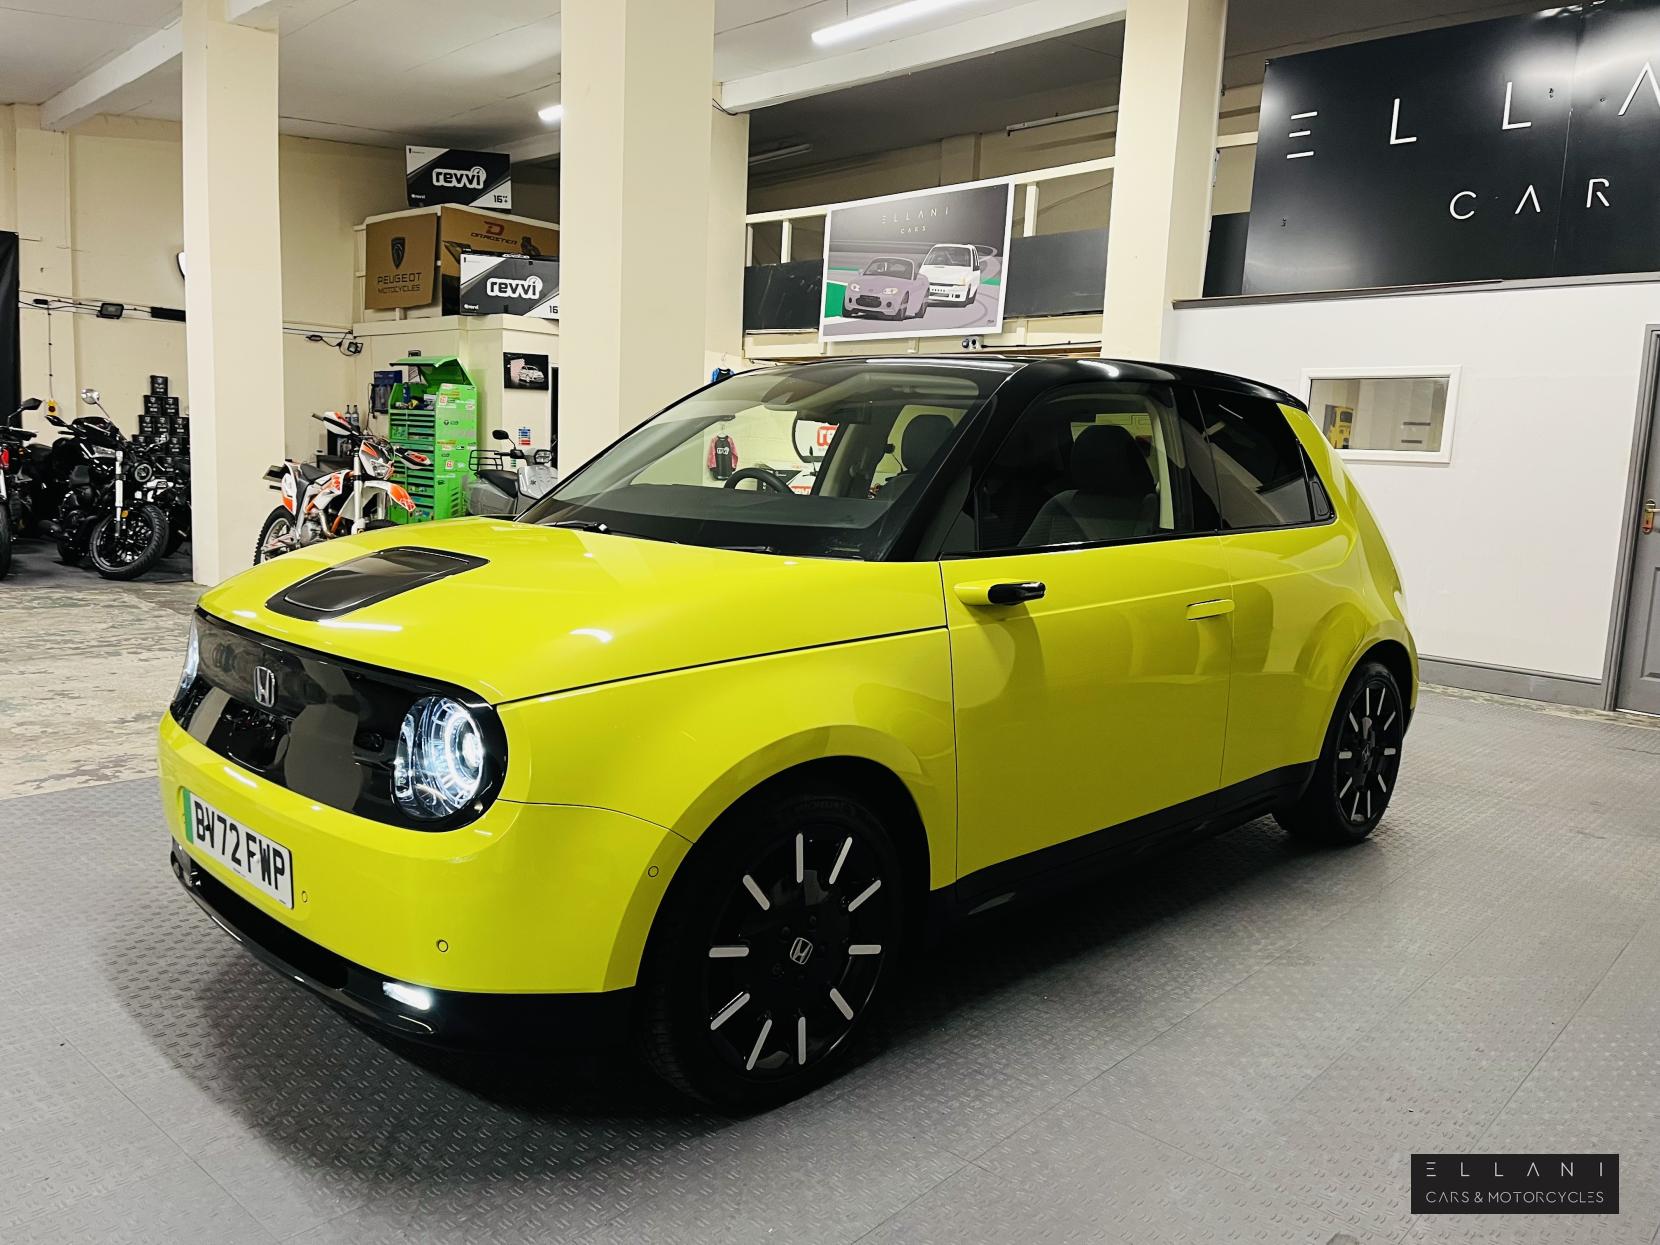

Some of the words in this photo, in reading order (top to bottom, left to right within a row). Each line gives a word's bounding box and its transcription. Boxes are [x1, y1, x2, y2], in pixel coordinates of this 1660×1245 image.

[434, 168, 484, 188] revvi
[1449, 178, 1611, 220] CAR
[880, 207, 949, 224] ELLANI
[900, 226, 927, 234] CARS
[377, 272, 422, 285] PEUGEOT
[488, 277, 541, 298] revvi
[194, 801, 242, 867] BV72
[246, 831, 285, 891] FWP
